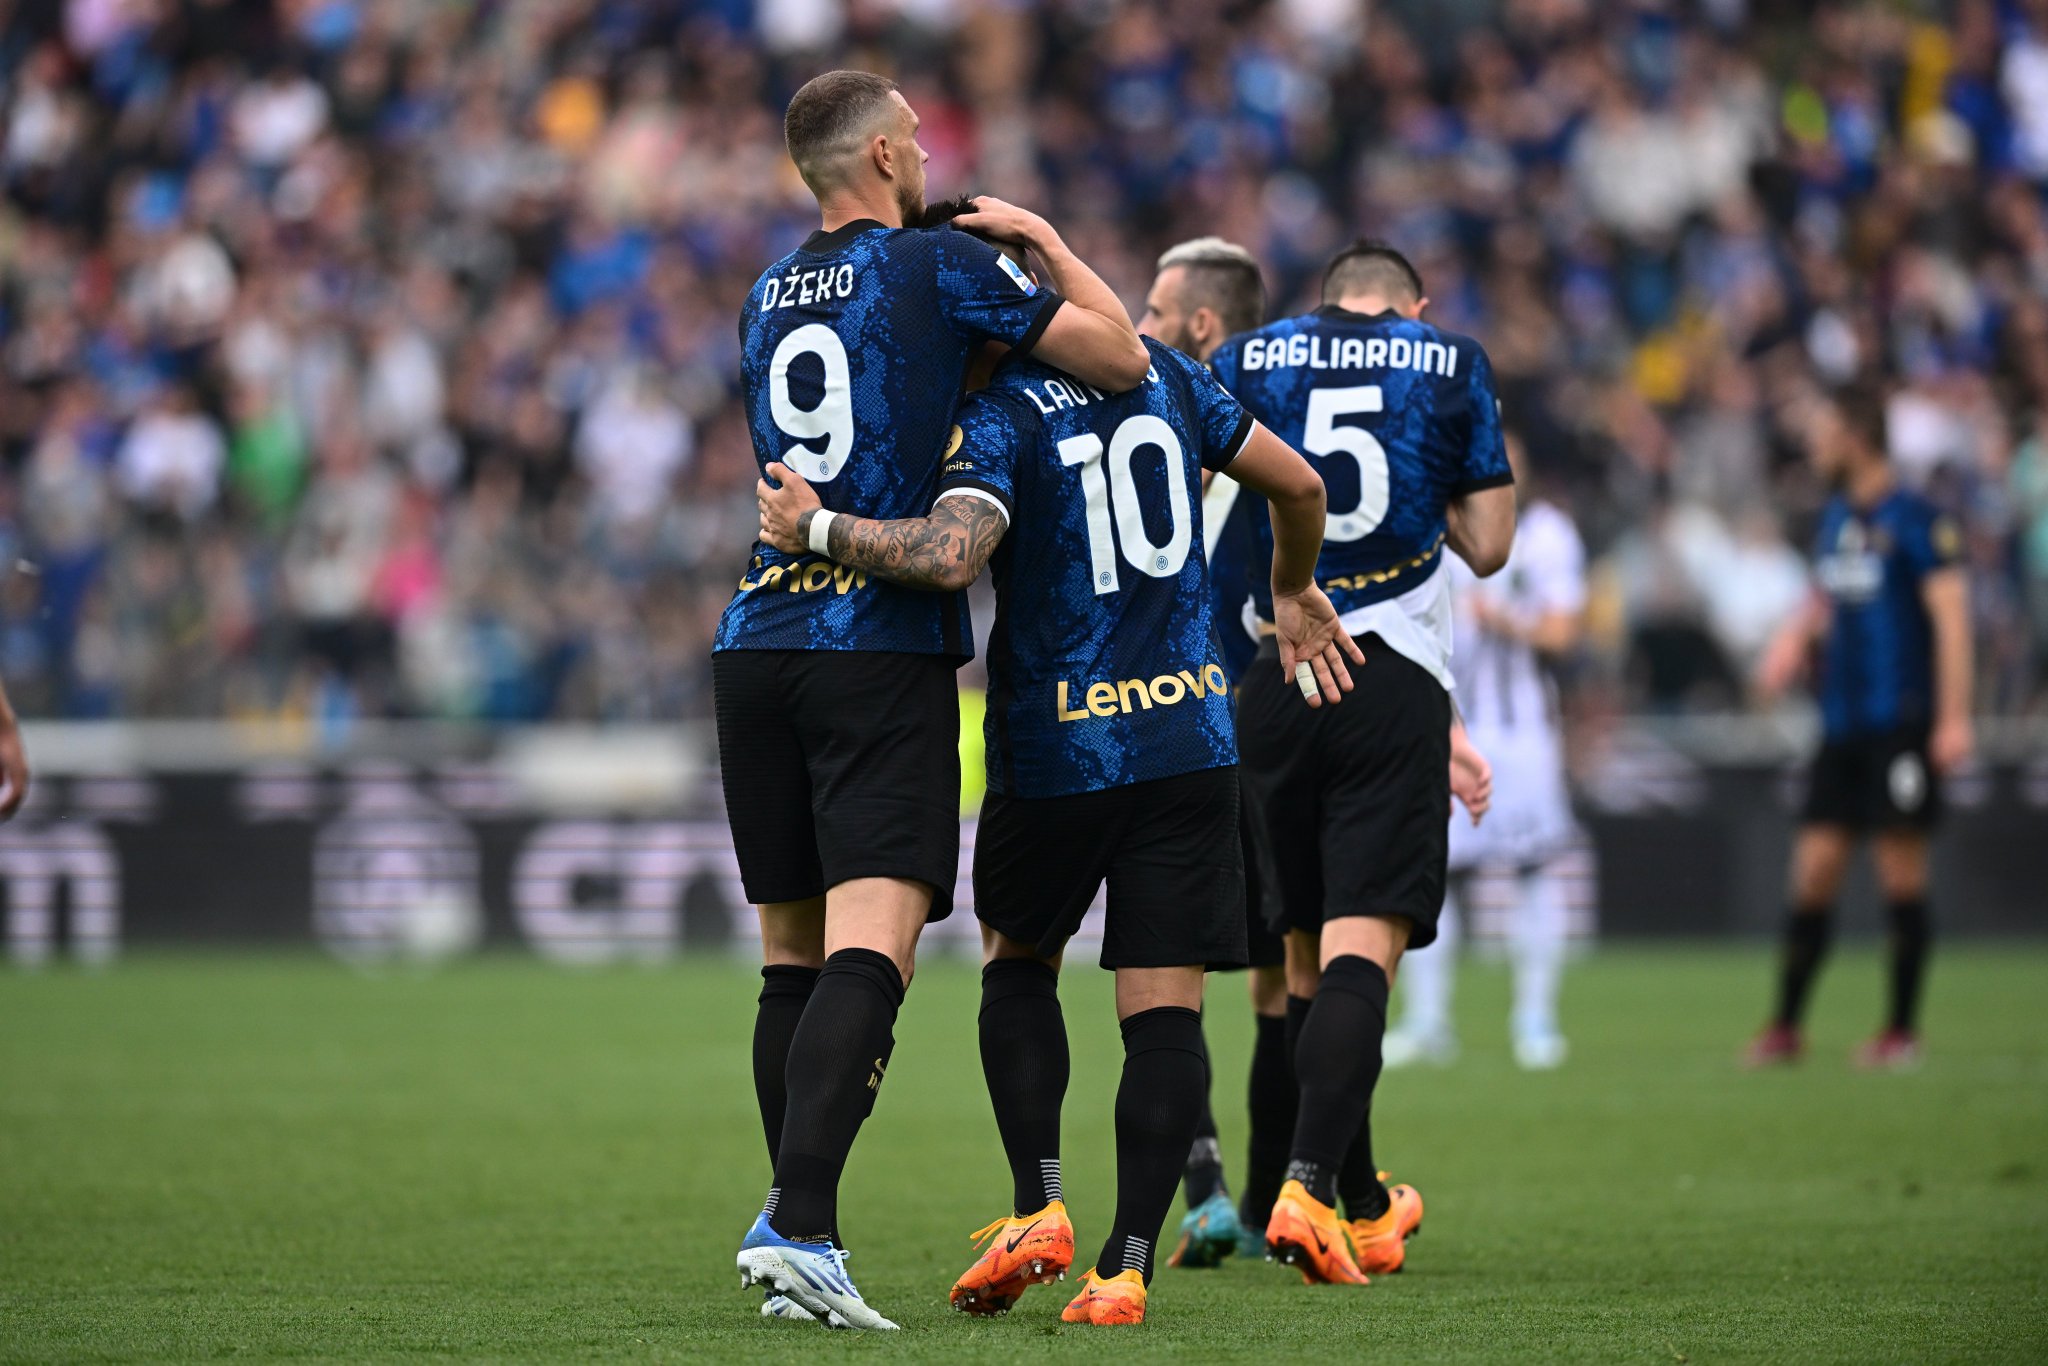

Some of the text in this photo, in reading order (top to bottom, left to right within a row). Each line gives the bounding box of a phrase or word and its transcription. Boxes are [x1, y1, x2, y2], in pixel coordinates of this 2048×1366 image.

[761, 264, 854, 312] DŽEKO
[769, 323, 854, 483] 9
[1243, 334, 1457, 377] GAGLIARDINI
[1057, 414, 1192, 595] 10
[1303, 385, 1390, 542] 5
[1057, 663, 1228, 722] Lenovo
